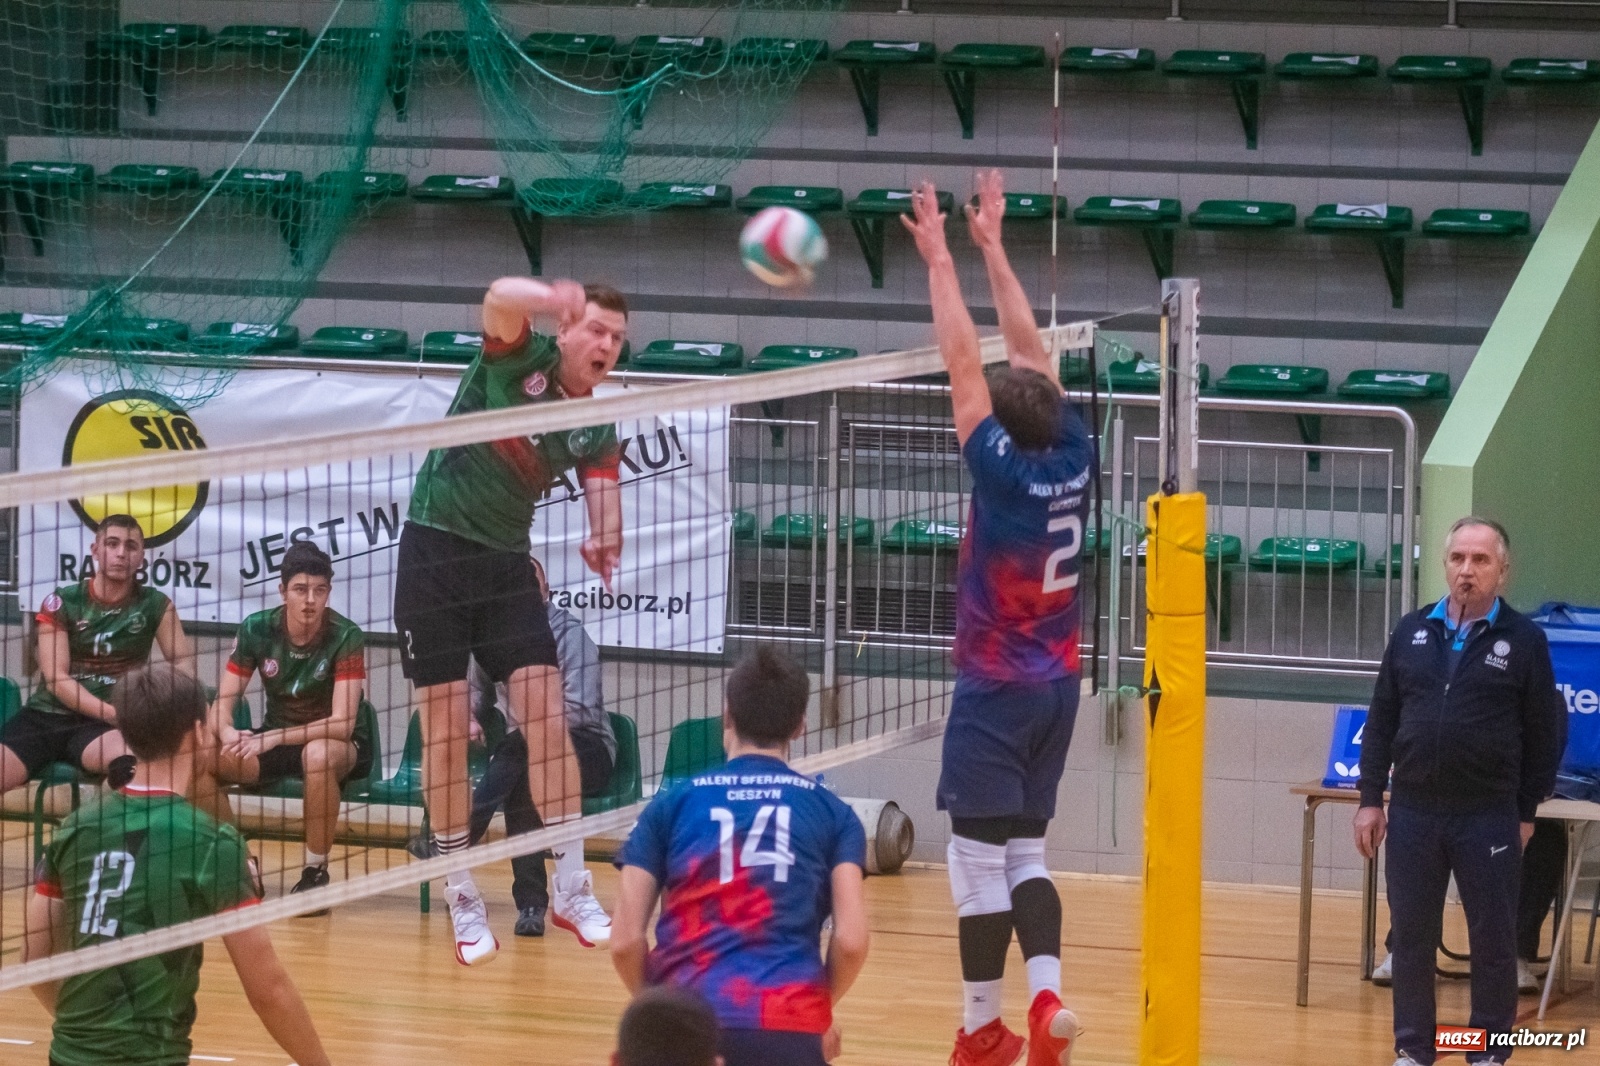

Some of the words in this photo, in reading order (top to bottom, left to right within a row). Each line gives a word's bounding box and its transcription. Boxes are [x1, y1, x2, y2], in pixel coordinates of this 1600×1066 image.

[130, 415, 207, 450] SIR
[357, 502, 400, 546] W
[60, 551, 213, 589] RABÓRZ
[1042, 514, 1082, 594] 2
[93, 631, 114, 657] 15
[693, 775, 739, 787] TALENT
[740, 774, 816, 791] SFERAWENT
[726, 789, 782, 801] CIESZYN
[710, 805, 795, 885] 14
[80, 851, 136, 937] 12
